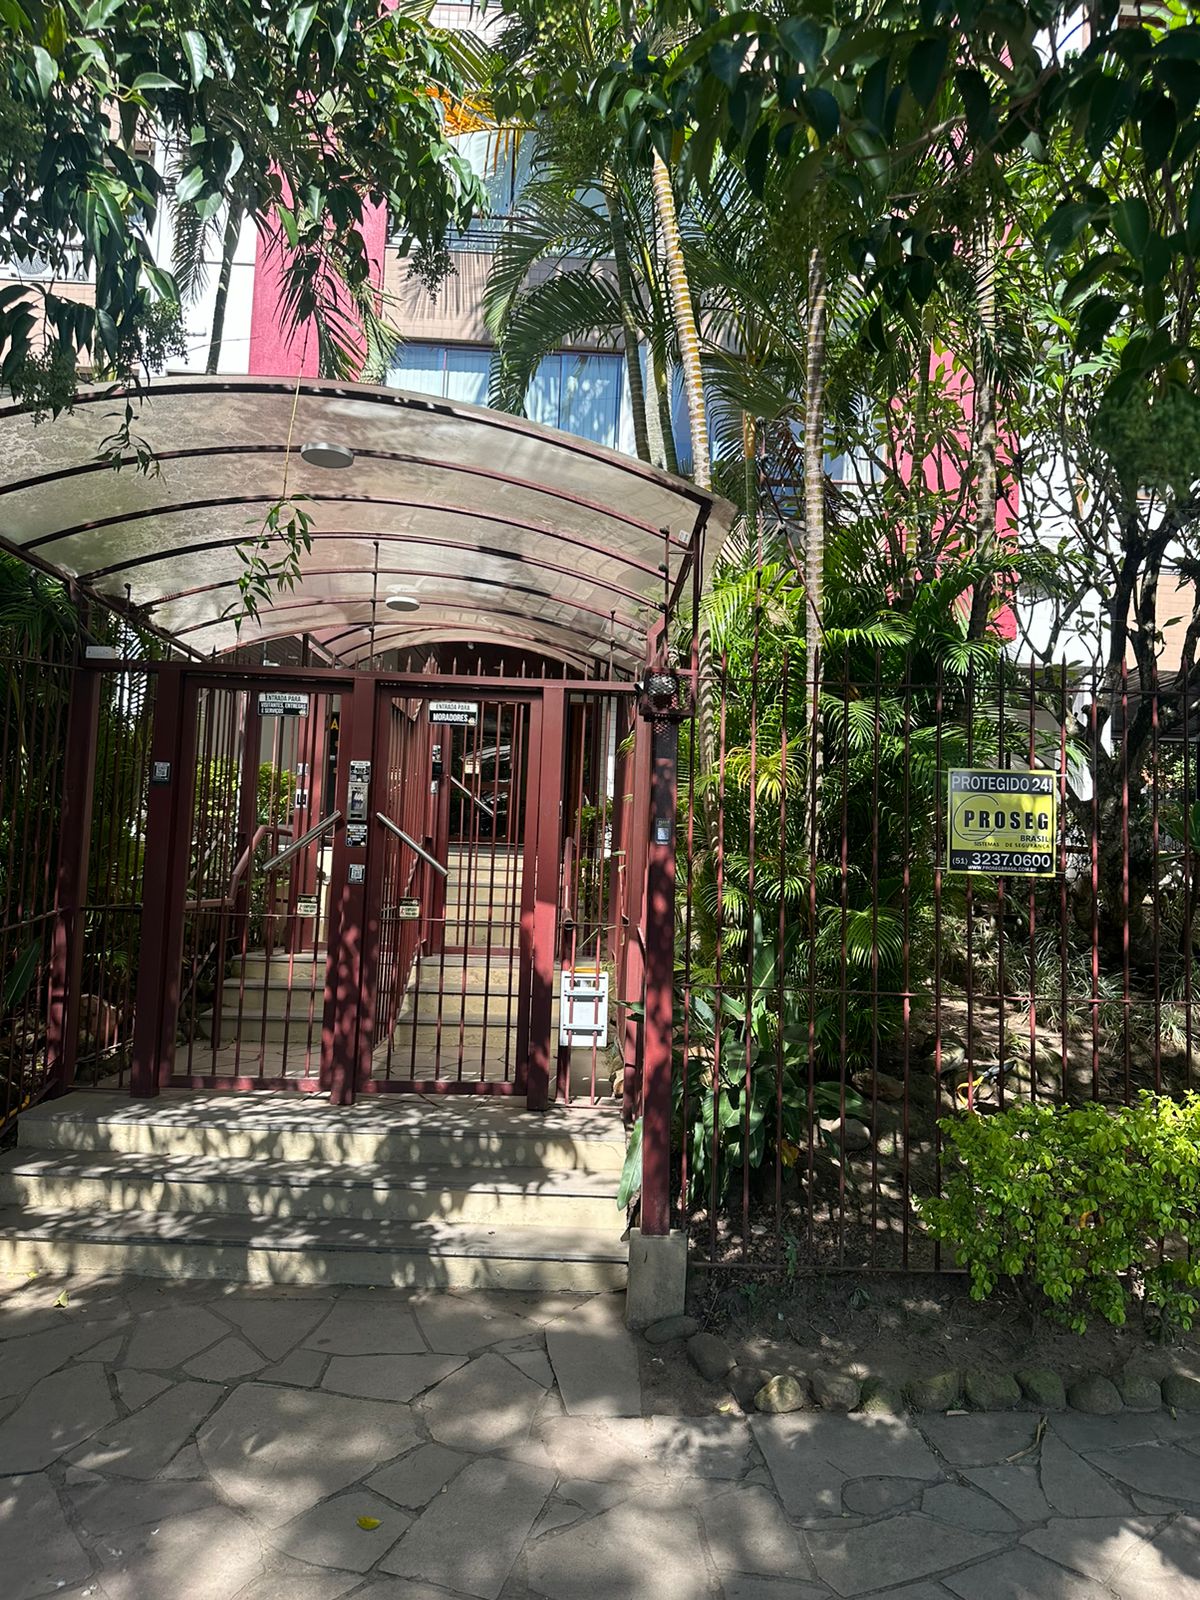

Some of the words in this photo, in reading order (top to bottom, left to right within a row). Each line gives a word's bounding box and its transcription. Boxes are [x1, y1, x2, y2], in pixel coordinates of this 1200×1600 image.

[265, 693, 287, 701] ENTRADA
[436, 703, 457, 711] ENTRADA
[432, 712, 468, 722] MORADORES
[952, 776, 1030, 792] PROTEGIDO
[964, 810, 1049, 830] PROSEG
[1020, 834, 1049, 843] BRASIL
[952, 857, 968, 866] (51)
[972, 852, 1051, 868] 3237.0600
